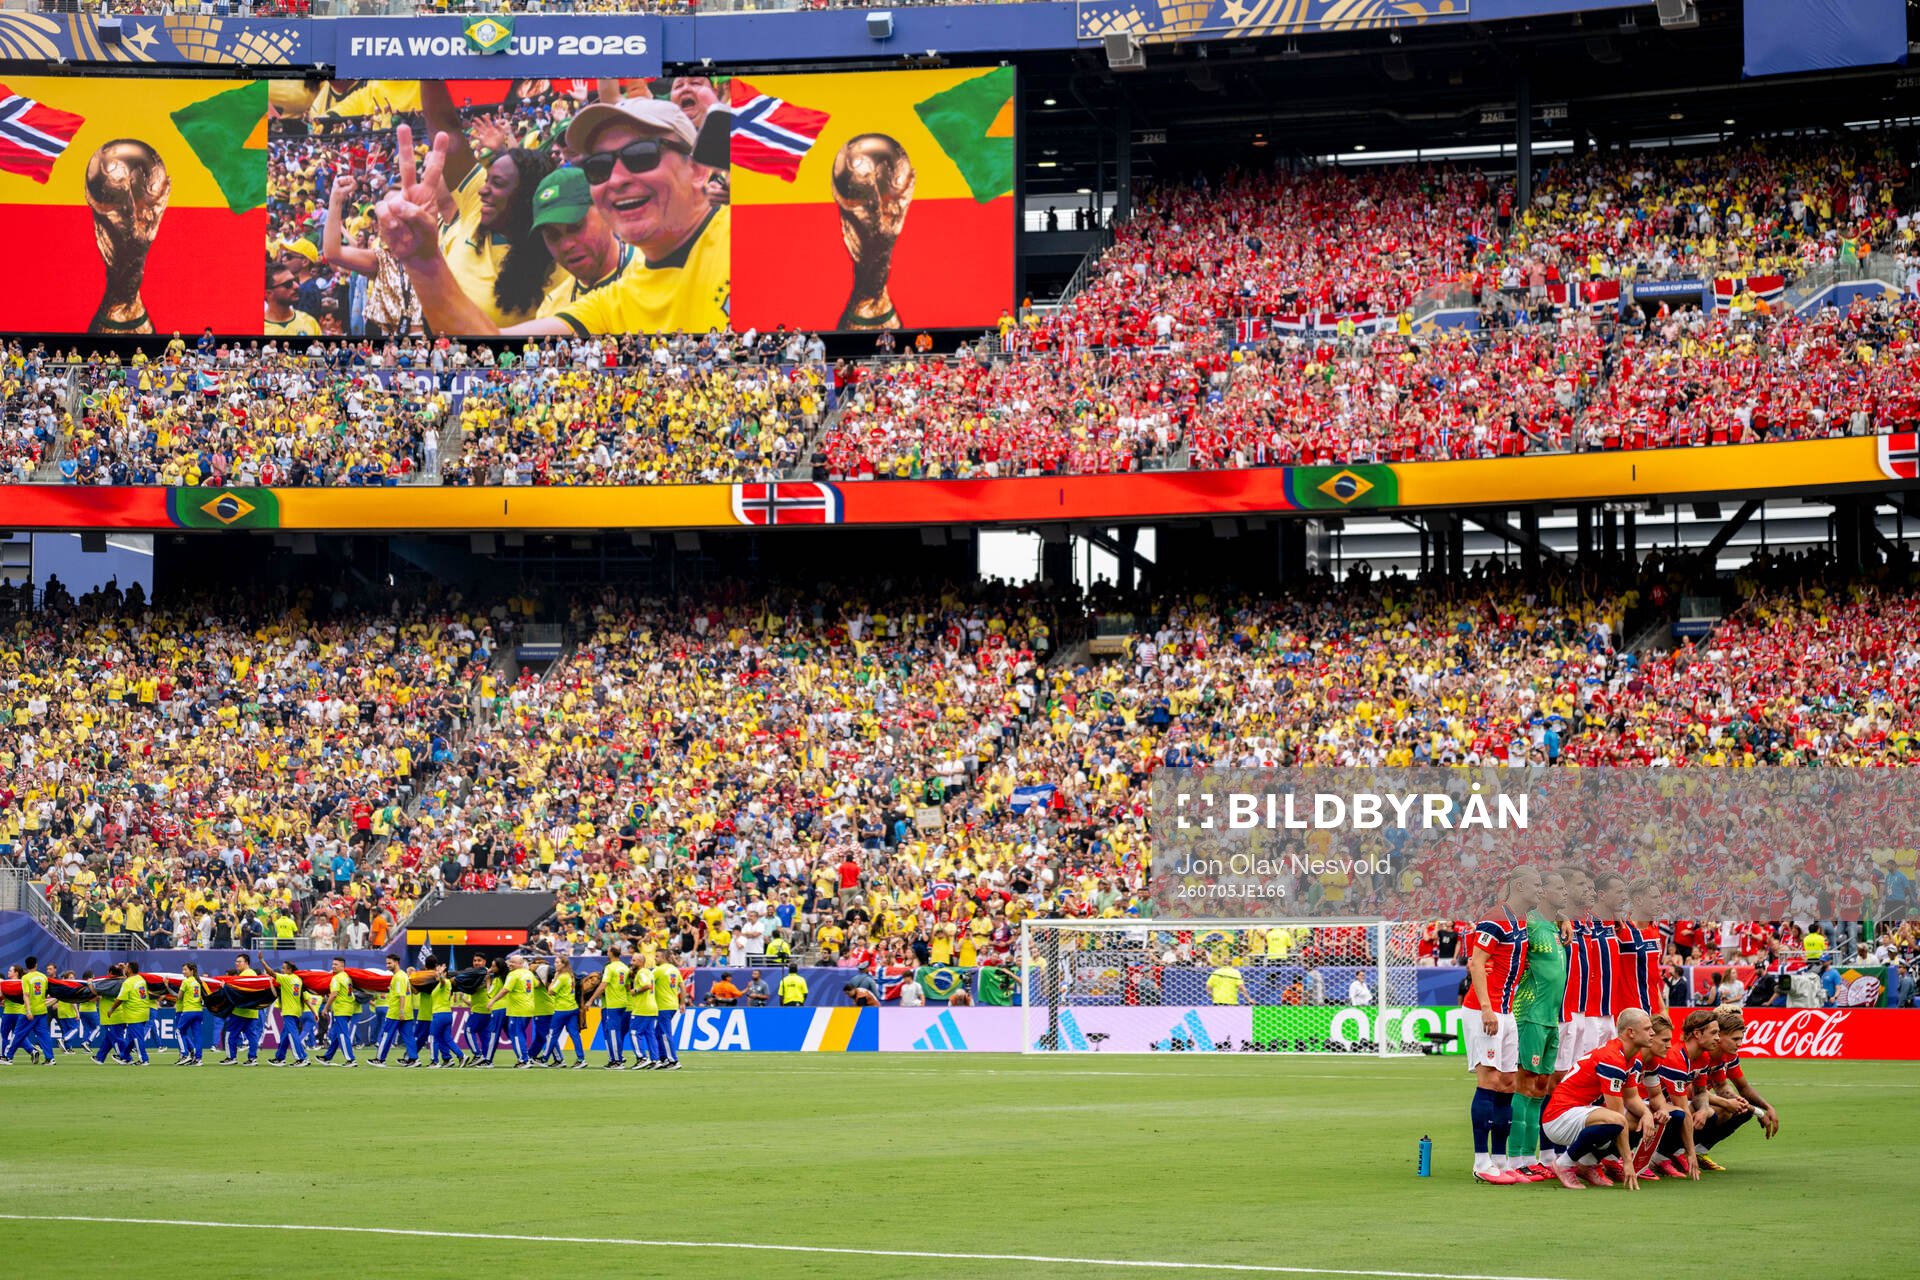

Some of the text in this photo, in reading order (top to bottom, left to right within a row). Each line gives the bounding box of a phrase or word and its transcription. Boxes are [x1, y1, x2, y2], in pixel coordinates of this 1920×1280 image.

[350, 37, 404, 56] FIFA
[408, 37, 496, 56] WOR
[557, 35, 648, 56] 2026
